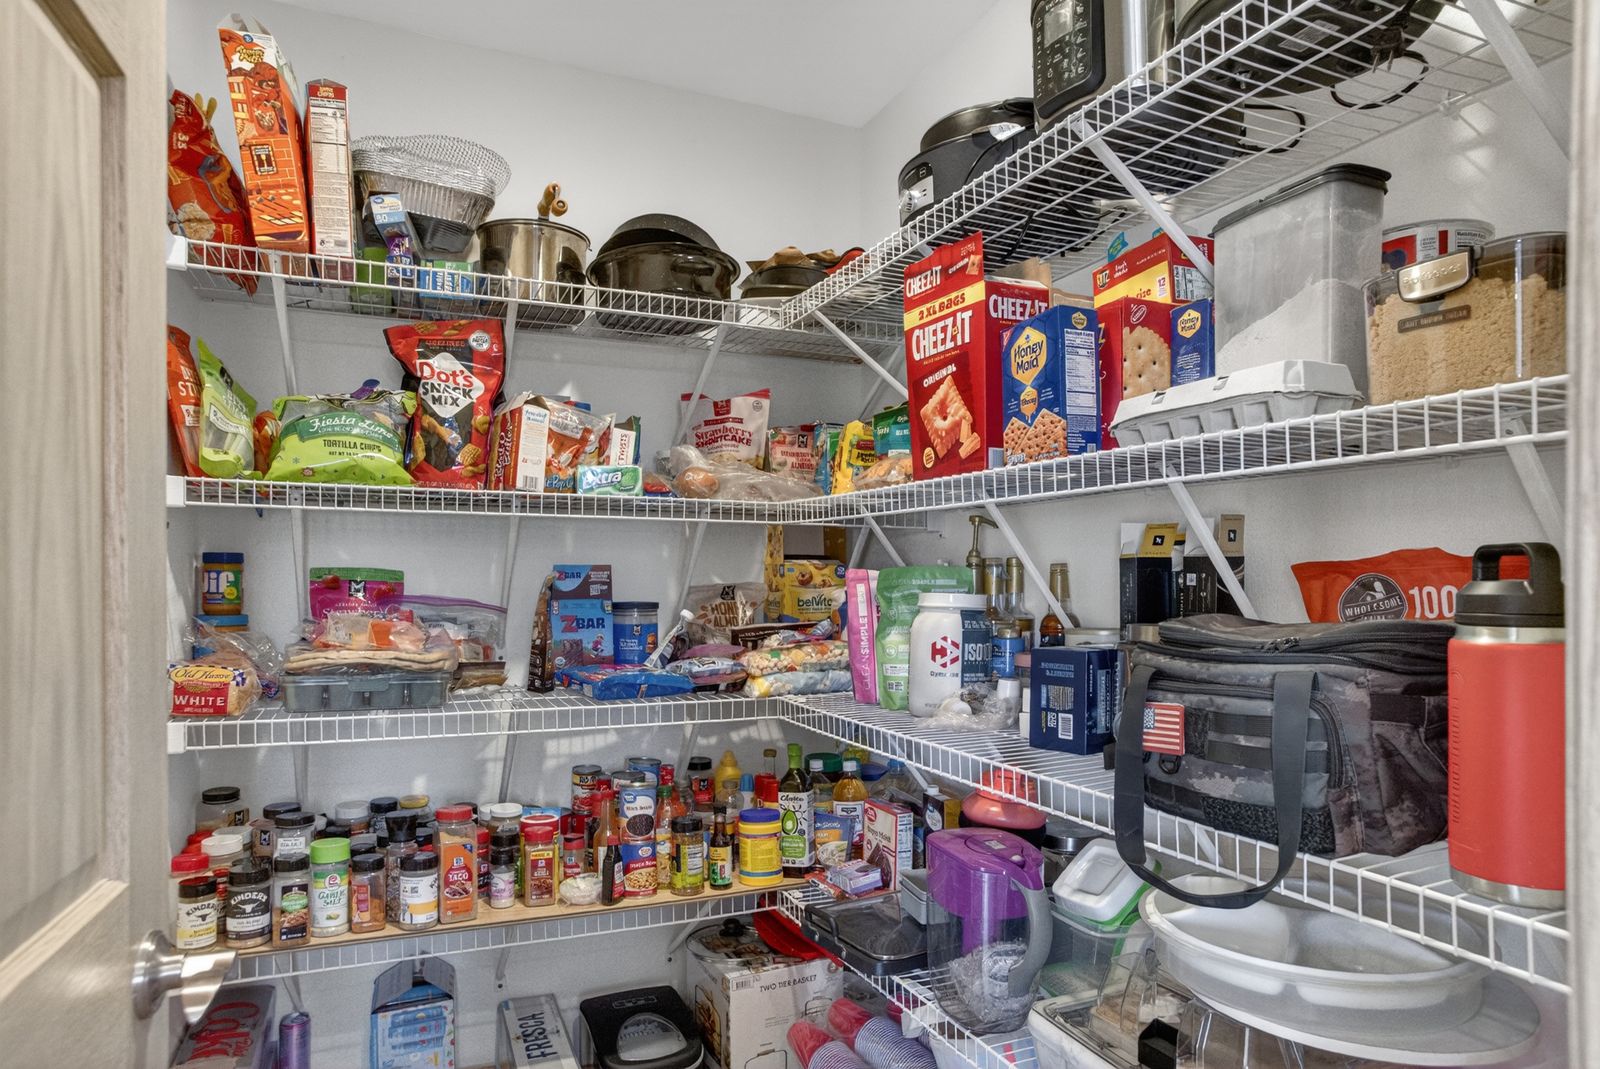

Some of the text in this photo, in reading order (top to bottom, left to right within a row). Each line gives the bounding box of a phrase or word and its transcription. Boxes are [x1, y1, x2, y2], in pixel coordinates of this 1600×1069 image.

[1014, 340, 1044, 363] Honey
[419, 361, 474, 388] Dot's
[1016, 356, 1039, 375] Maid
[923, 363, 957, 388] ORIGINAL
[421, 381, 474, 401] SNACK
[431, 394, 460, 407] MIX
[309, 415, 356, 432] Fiesta
[322, 439, 358, 450] TORTILLA
[174, 695, 225, 706] WHITE
[760, 983, 777, 992] TWO
[517, 1011, 558, 1060] FRESCA
